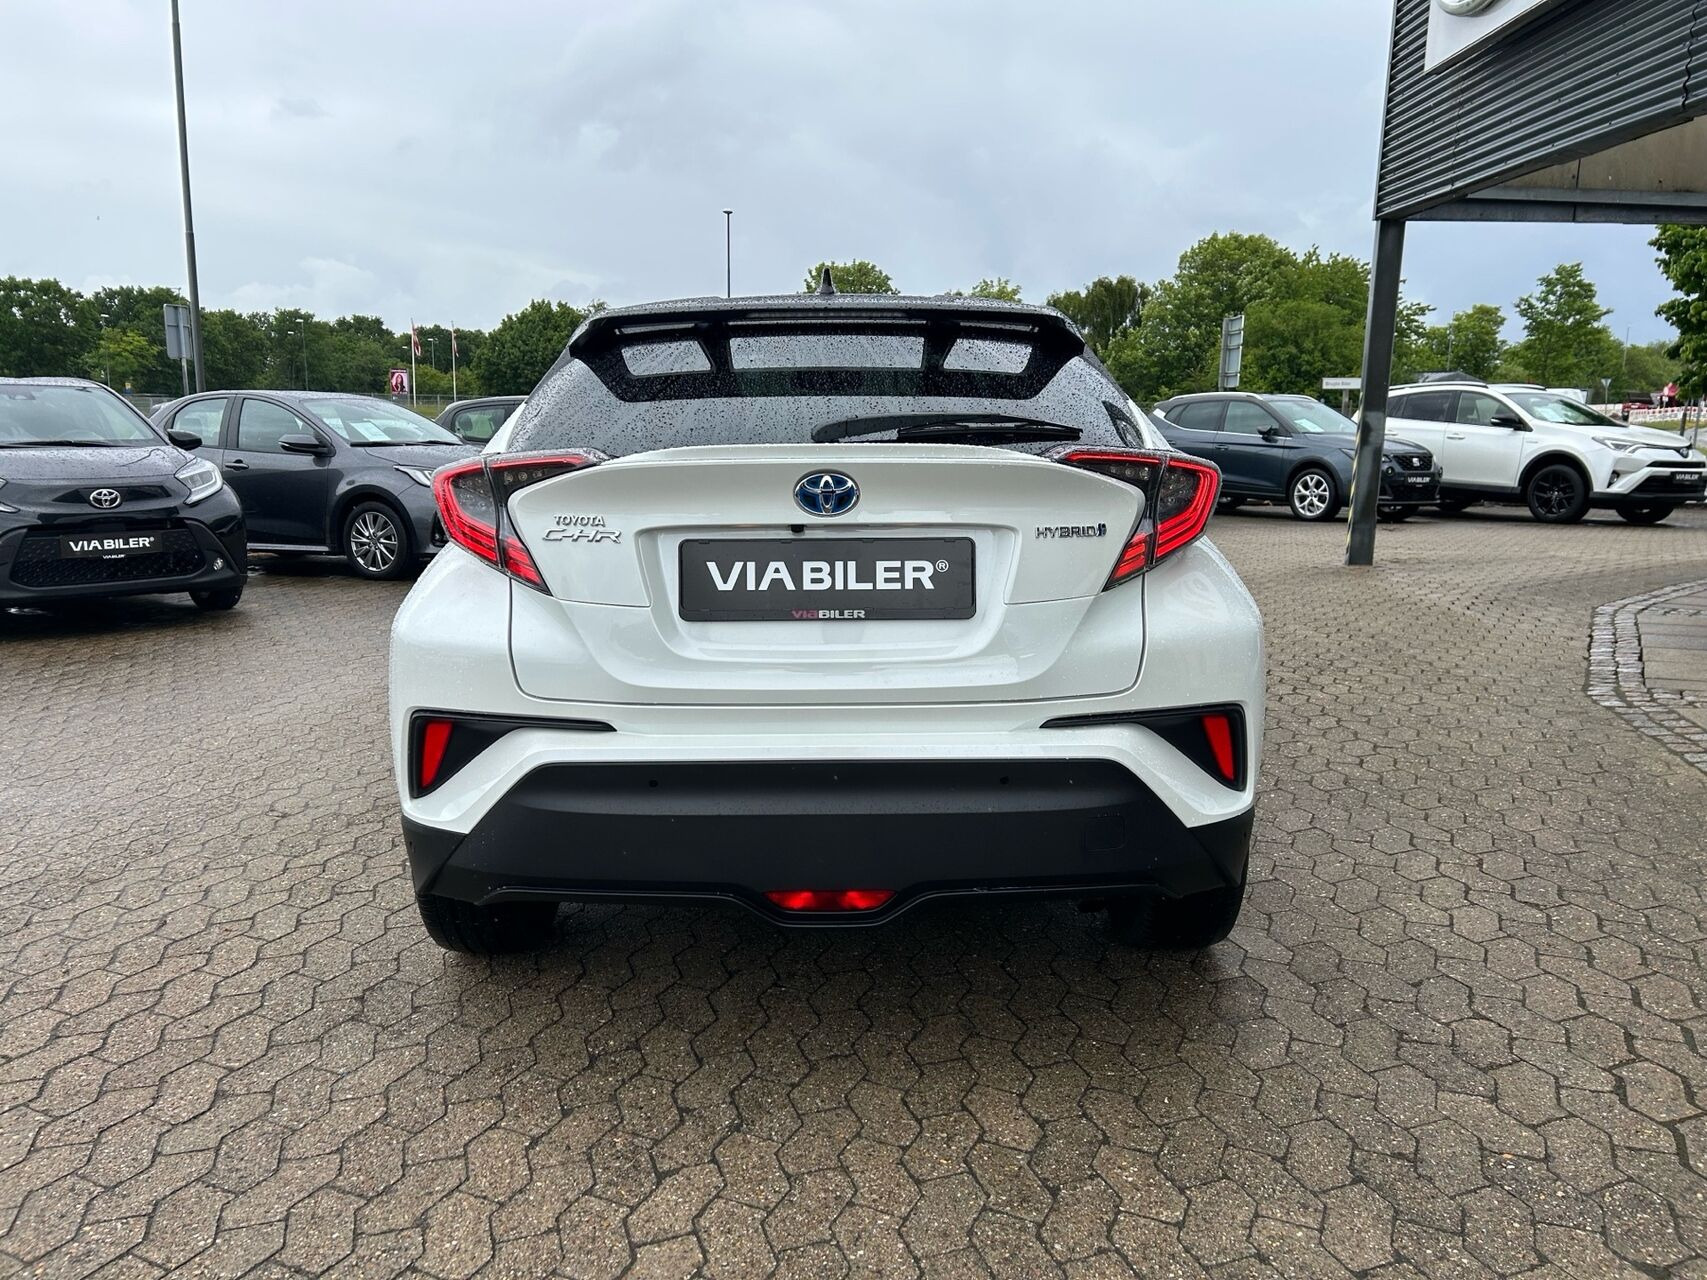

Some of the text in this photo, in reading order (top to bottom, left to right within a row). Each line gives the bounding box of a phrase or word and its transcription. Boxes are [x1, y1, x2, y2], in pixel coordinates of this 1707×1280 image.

[553, 515, 606, 527] TOYOTA
[542, 529, 622, 544] C-HR
[1035, 526, 1096, 539] HYBRID
